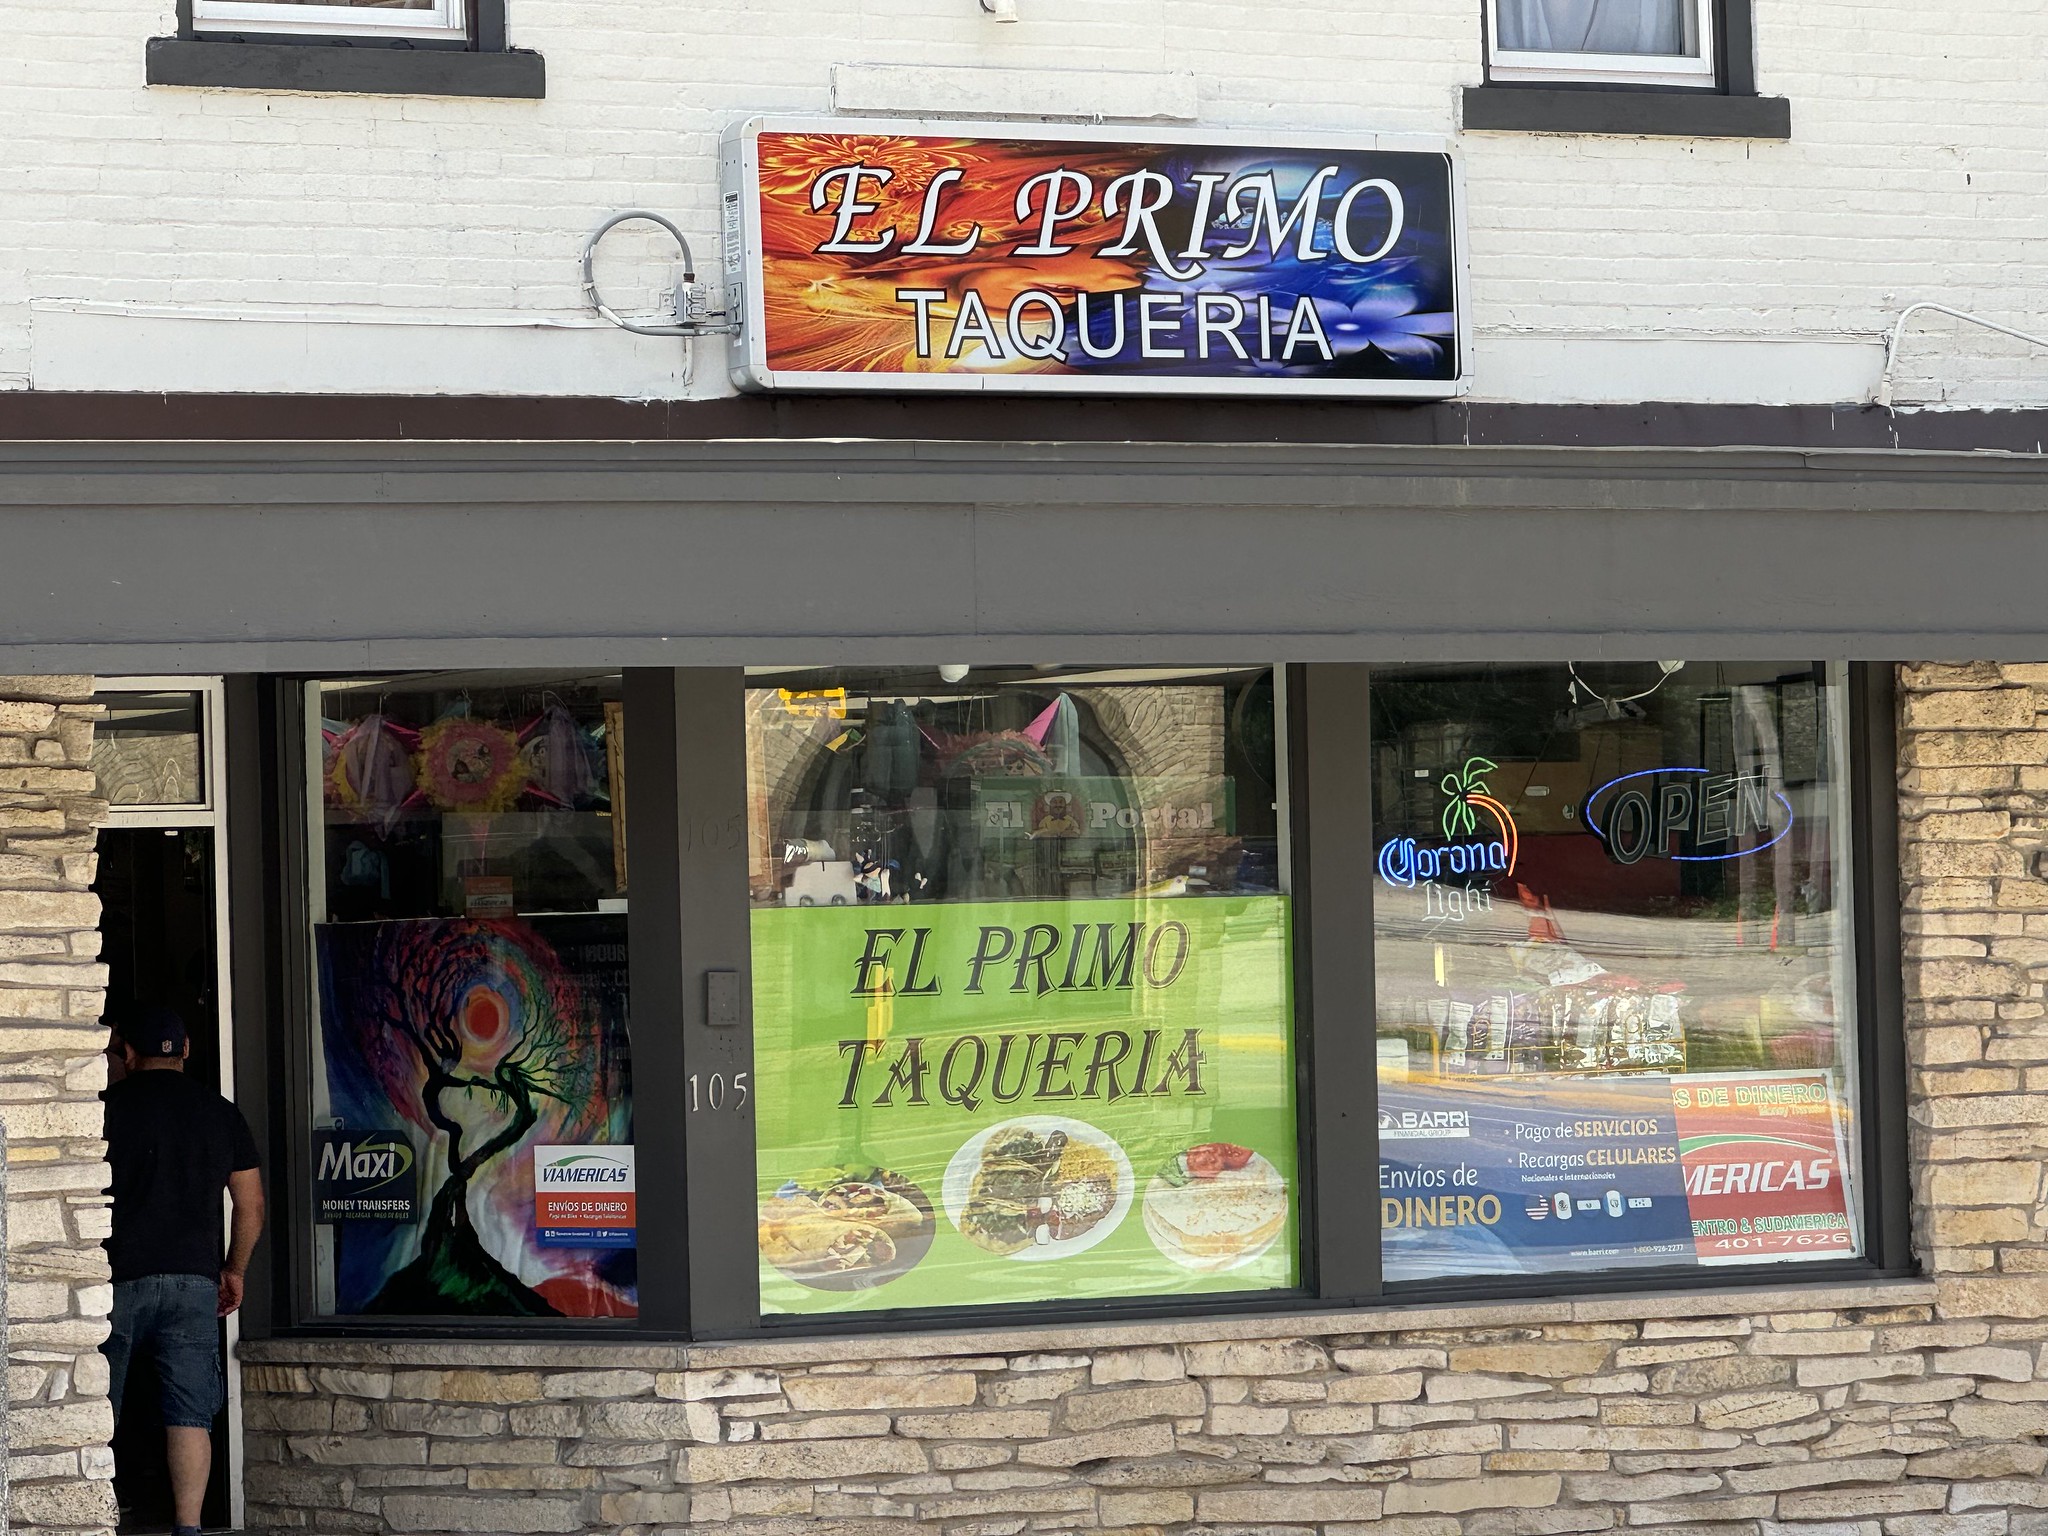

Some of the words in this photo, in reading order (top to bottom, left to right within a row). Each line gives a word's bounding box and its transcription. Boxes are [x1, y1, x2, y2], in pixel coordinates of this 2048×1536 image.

[811, 161, 981, 256] EL
[1014, 164, 1406, 281] PRIMO
[895, 288, 1335, 363] TAQUERIA
[985, 801, 1025, 828] El
[1090, 801, 1216, 830] Portal
[1603, 764, 1772, 865] OPEN
[1379, 837, 1506, 888] Corona
[850, 927, 942, 998] EL
[963, 920, 1191, 999] PRIMO
[837, 1028, 1207, 1112] TAQUERIA
[688, 1072, 748, 1111] 105
[1697, 1086, 1730, 1109] DE
[1736, 1083, 1827, 1106] DINERO
[1402, 1111, 1470, 1129] BARRI
[1515, 1122, 1551, 1143] Pago
[1555, 1121, 1574, 1139] de
[1574, 1118, 1658, 1138] SERVICIOS
[318, 1142, 396, 1181] Maxi
[1519, 1150, 1585, 1171] Recargas
[1586, 1146, 1677, 1167] CELULARES
[543, 1165, 628, 1183] VIAMERICAS
[1379, 1163, 1446, 1189] Envíos
[1452, 1162, 1478, 1187] de
[1683, 1158, 1834, 1196] MERICAS
[322, 1200, 355, 1211] MONEY
[357, 1199, 410, 1211] TRANSFERS
[548, 1200, 580, 1212] ENVÍOS
[581, 1202, 593, 1212] DE
[595, 1202, 628, 1212] DINERO
[1381, 1194, 1502, 1228] DINERO
[1741, 1217, 1754, 1234] &
[1754, 1212, 1848, 1234] SUDAMERICA
[1715, 1232, 1848, 1250] 401-7626
